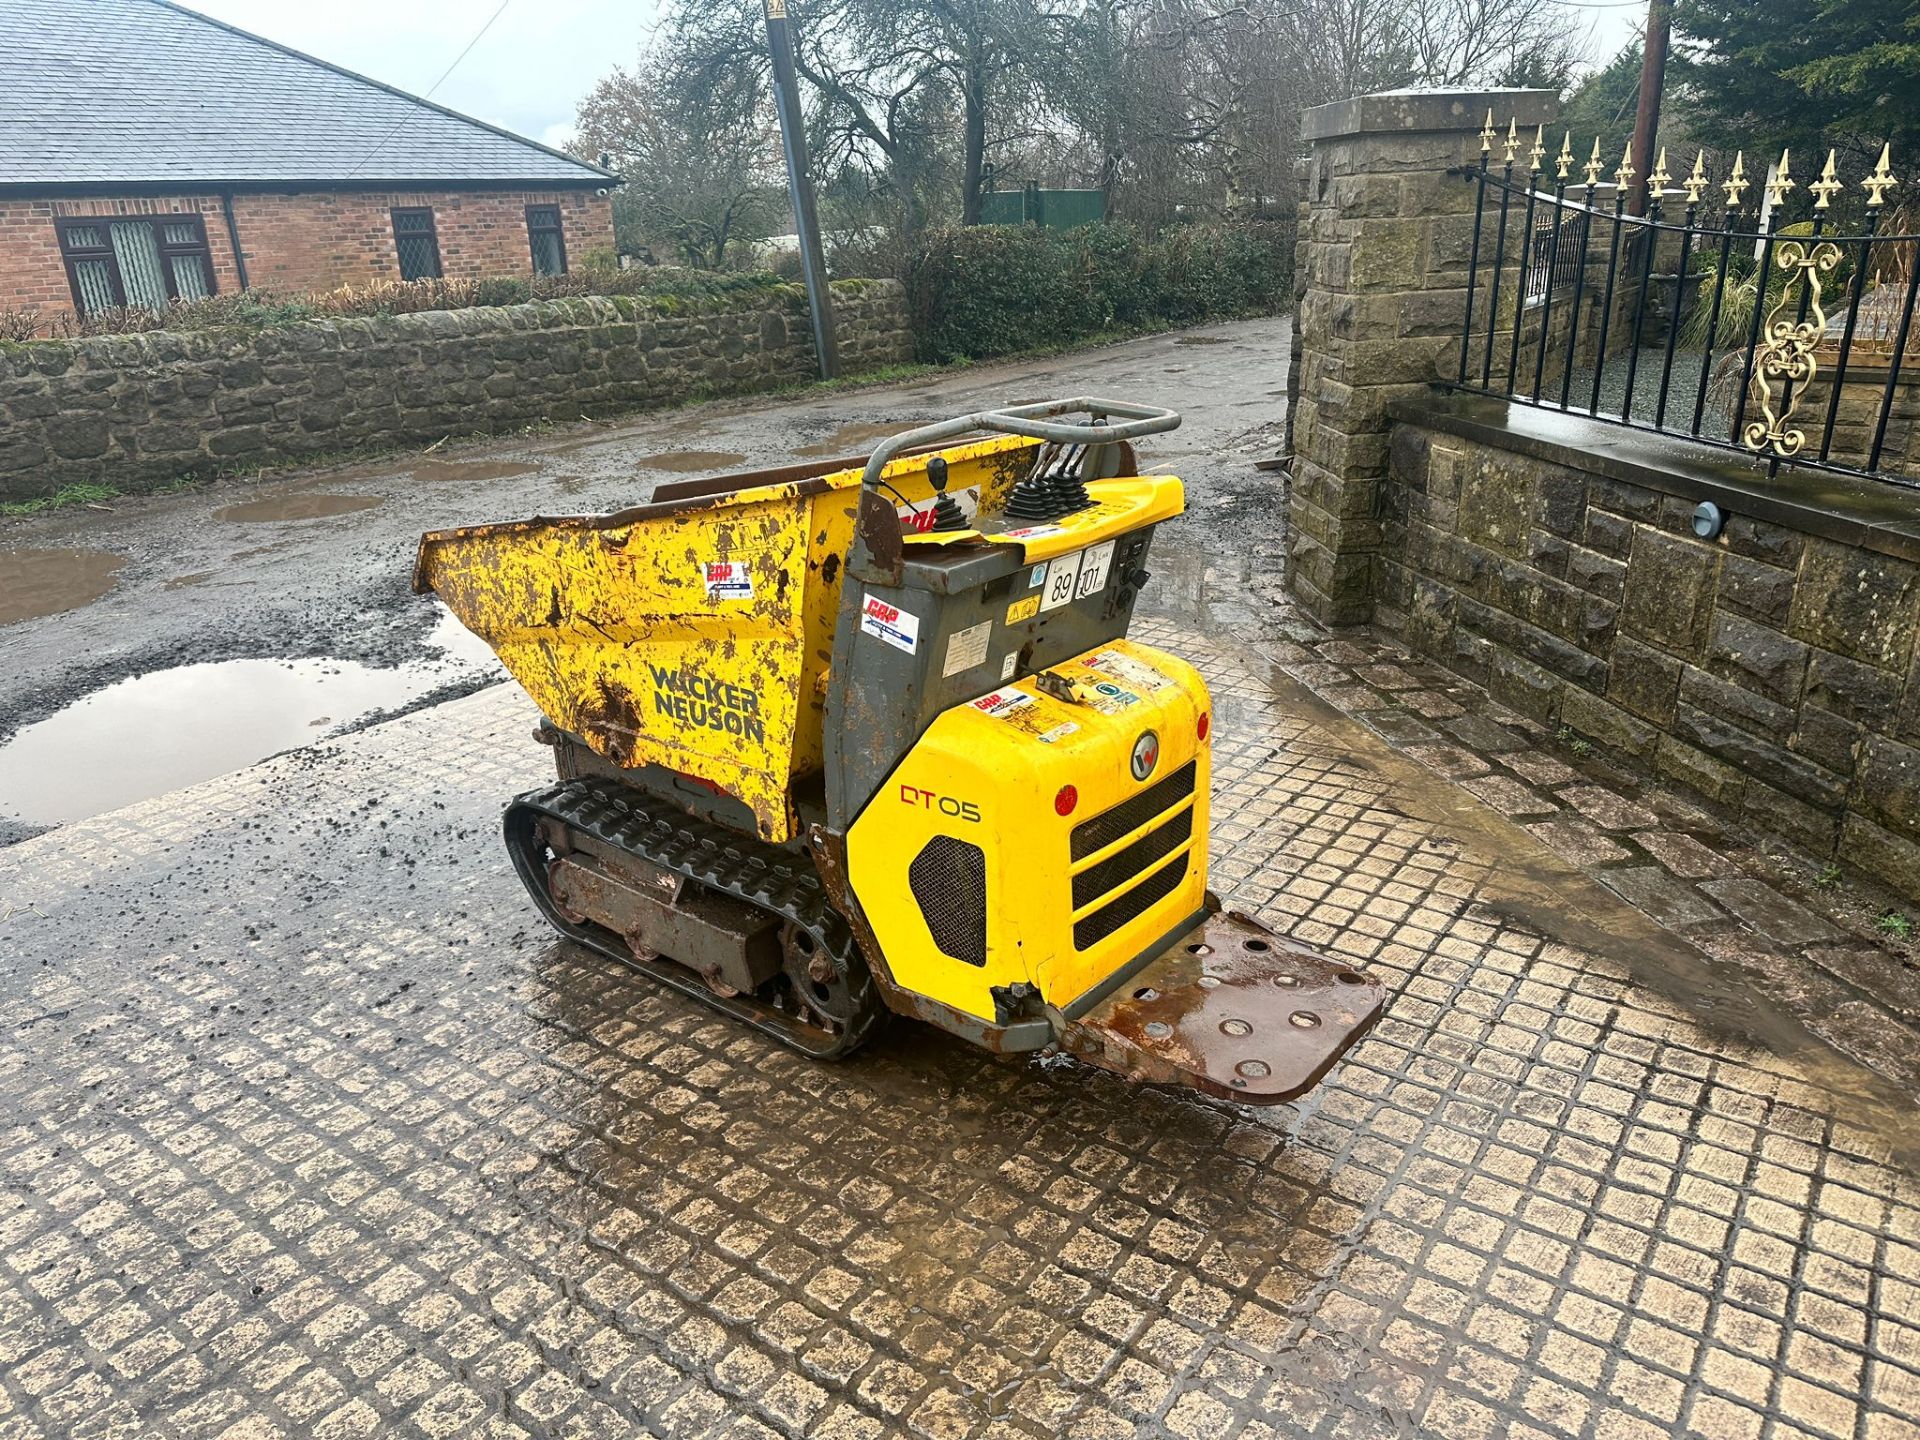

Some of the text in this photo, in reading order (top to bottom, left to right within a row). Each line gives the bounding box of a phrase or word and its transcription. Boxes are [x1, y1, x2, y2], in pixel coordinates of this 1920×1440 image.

[1052, 573, 1072, 602] 89
[1081, 566, 1099, 594] 101
[867, 599, 899, 624] GAP
[648, 663, 762, 717] WACKER
[974, 693, 1002, 710] GAP
[654, 690, 765, 744] NEUSON
